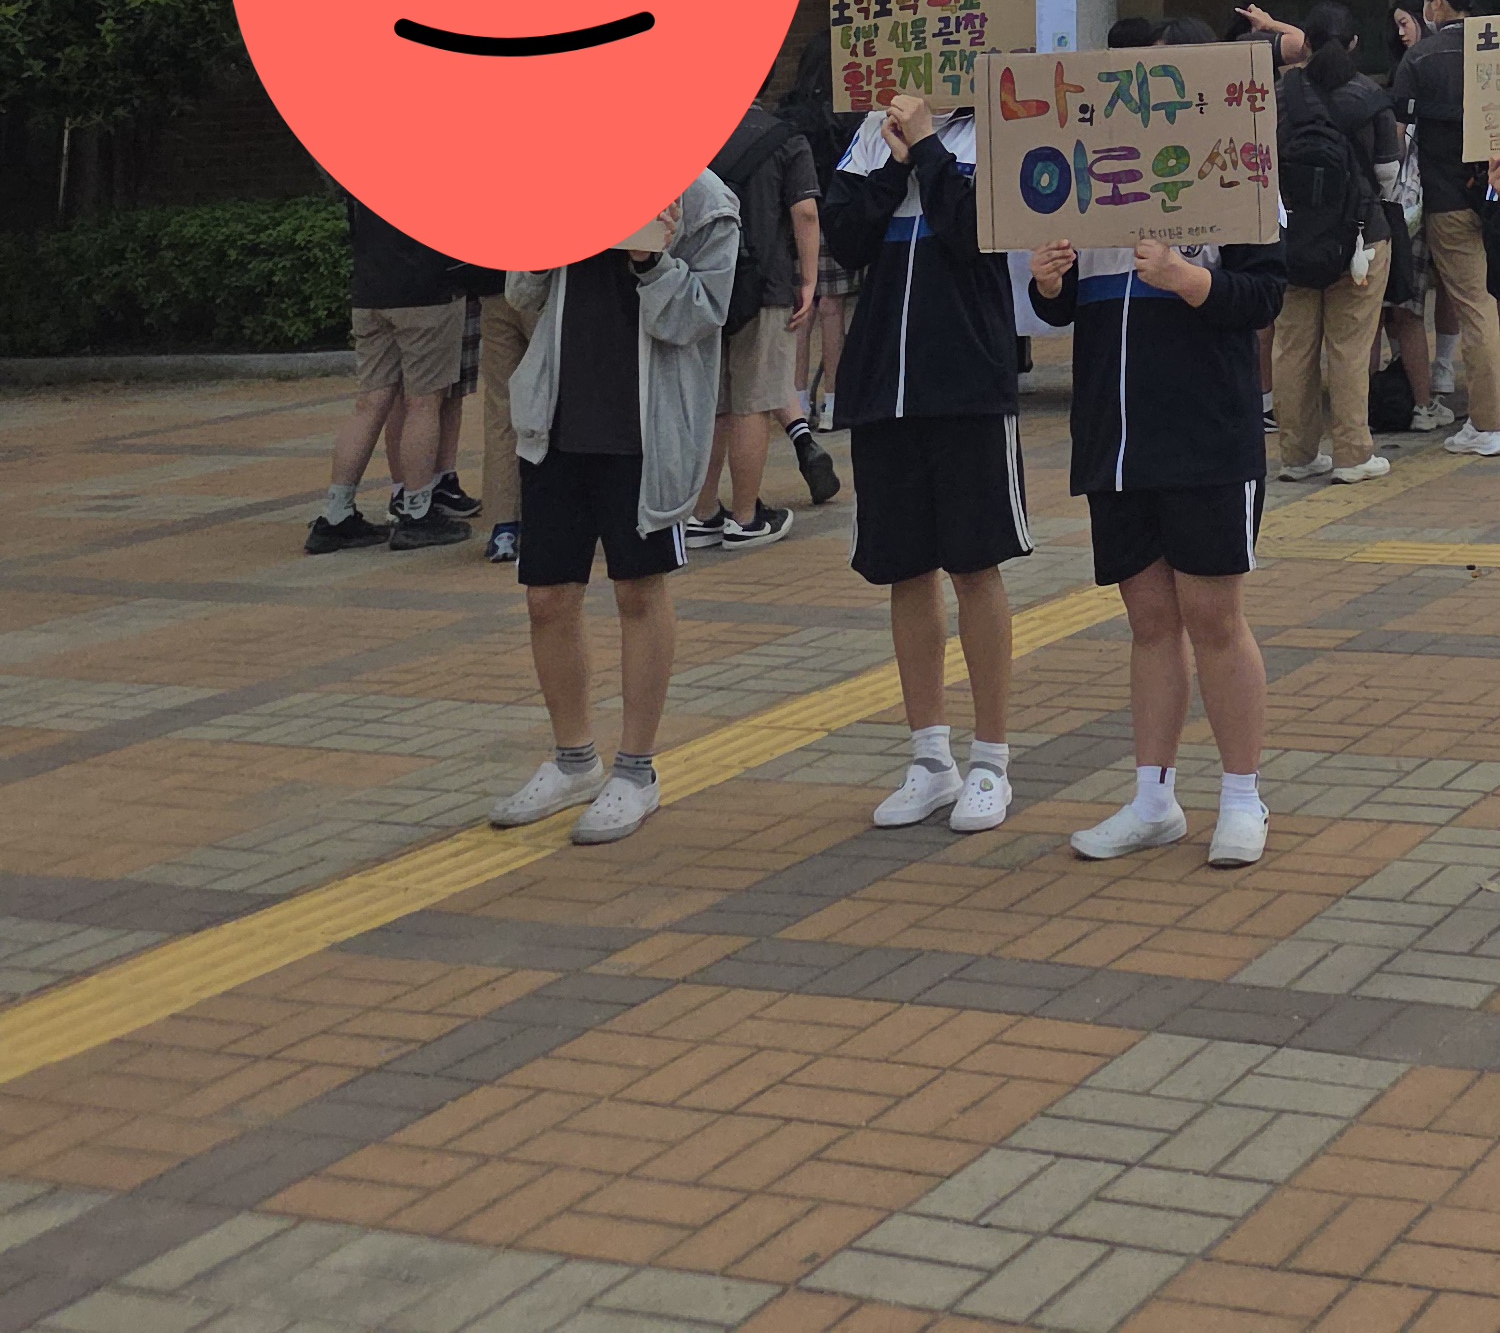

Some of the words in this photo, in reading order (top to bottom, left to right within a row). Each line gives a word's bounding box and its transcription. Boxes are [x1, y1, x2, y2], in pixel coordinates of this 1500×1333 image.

[840, 23, 879, 57] 텃밭
[888, 17, 927, 52] 식물
[932, 12, 988, 46] 관찰
[842, 52, 932, 111] 활동지
[1000, 61, 1095, 128] 나와
[1098, 61, 1208, 128] 지구를
[1224, 80, 1269, 112] 위한
[1020, 139, 1194, 214] 이로운
[1198, 137, 1272, 188] 선택
